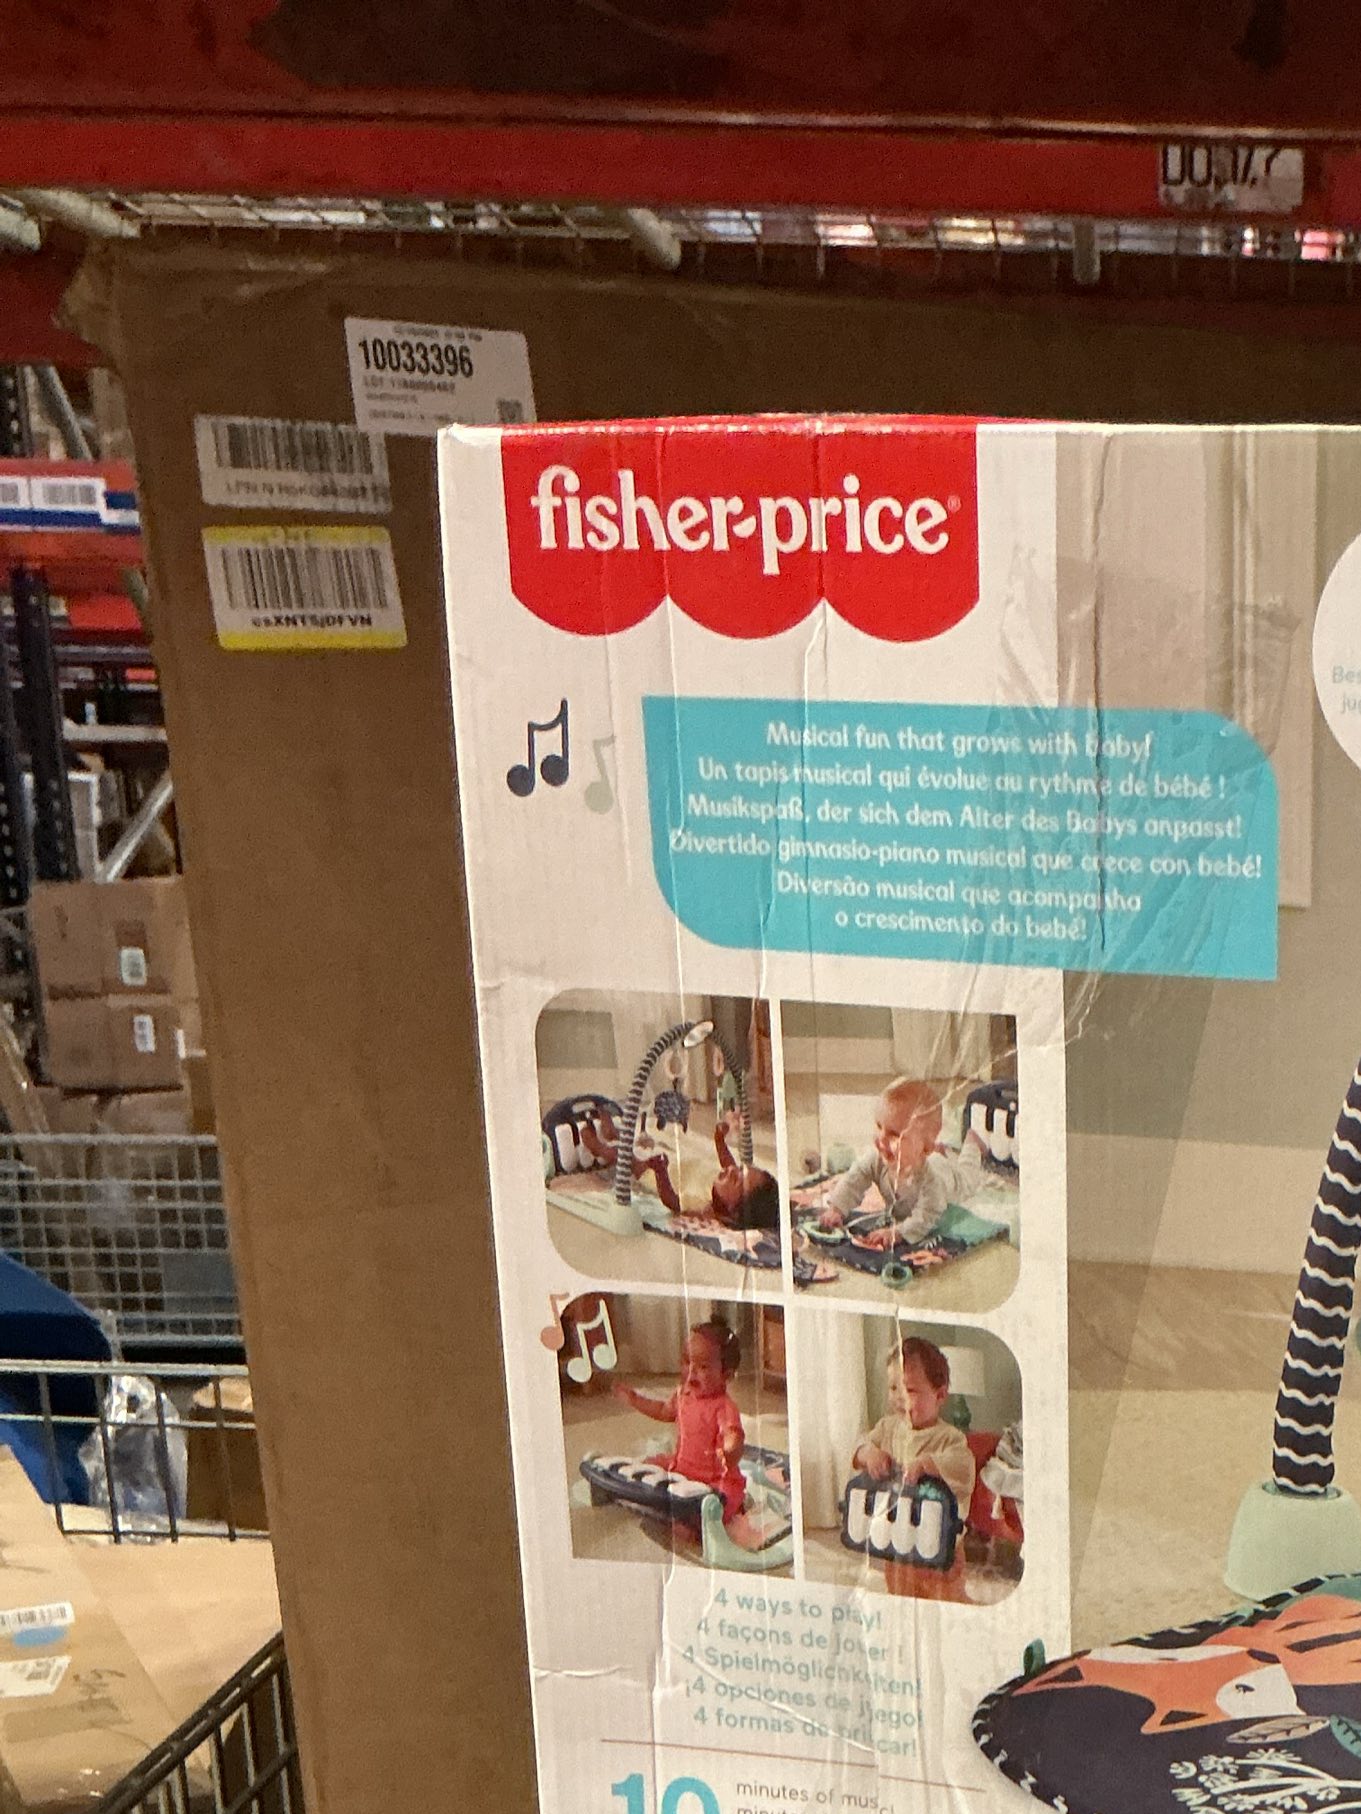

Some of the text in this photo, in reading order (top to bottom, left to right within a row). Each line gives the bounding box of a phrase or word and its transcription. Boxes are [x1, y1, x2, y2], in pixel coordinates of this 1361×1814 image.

[359, 338, 473, 378] 10033396
[766, 722, 1077, 758] Musical fun that grows with
[698, 757, 1212, 799] Un tapis musical qui évolue au rythme de bébé
[817, 799, 851, 823] der
[858, 801, 899, 825] sich
[905, 803, 952, 828] dem
[959, 805, 1015, 829] Alter
[1021, 808, 1060, 833] des
[1066, 809, 1138, 840] Babys
[1144, 814, 1242, 842] anpasst!
[669, 828, 1262, 879] Divertido gimnasio-piano musical que crece con bebé!
[776, 869, 870, 898] Diversão
[876, 879, 955, 902] musical
[961, 884, 1000, 908] que
[834, 909, 1087, 941] o crescimento do bebé!
[714, 1588, 822, 1619] 4 ways to
[697, 1615, 829, 1649] 4 façons de
[714, 1682, 817, 1708] opciones
[693, 1706, 795, 1734] 4 formas
[736, 1781, 809, 1801] minutes
[816, 1789, 835, 1804] of
